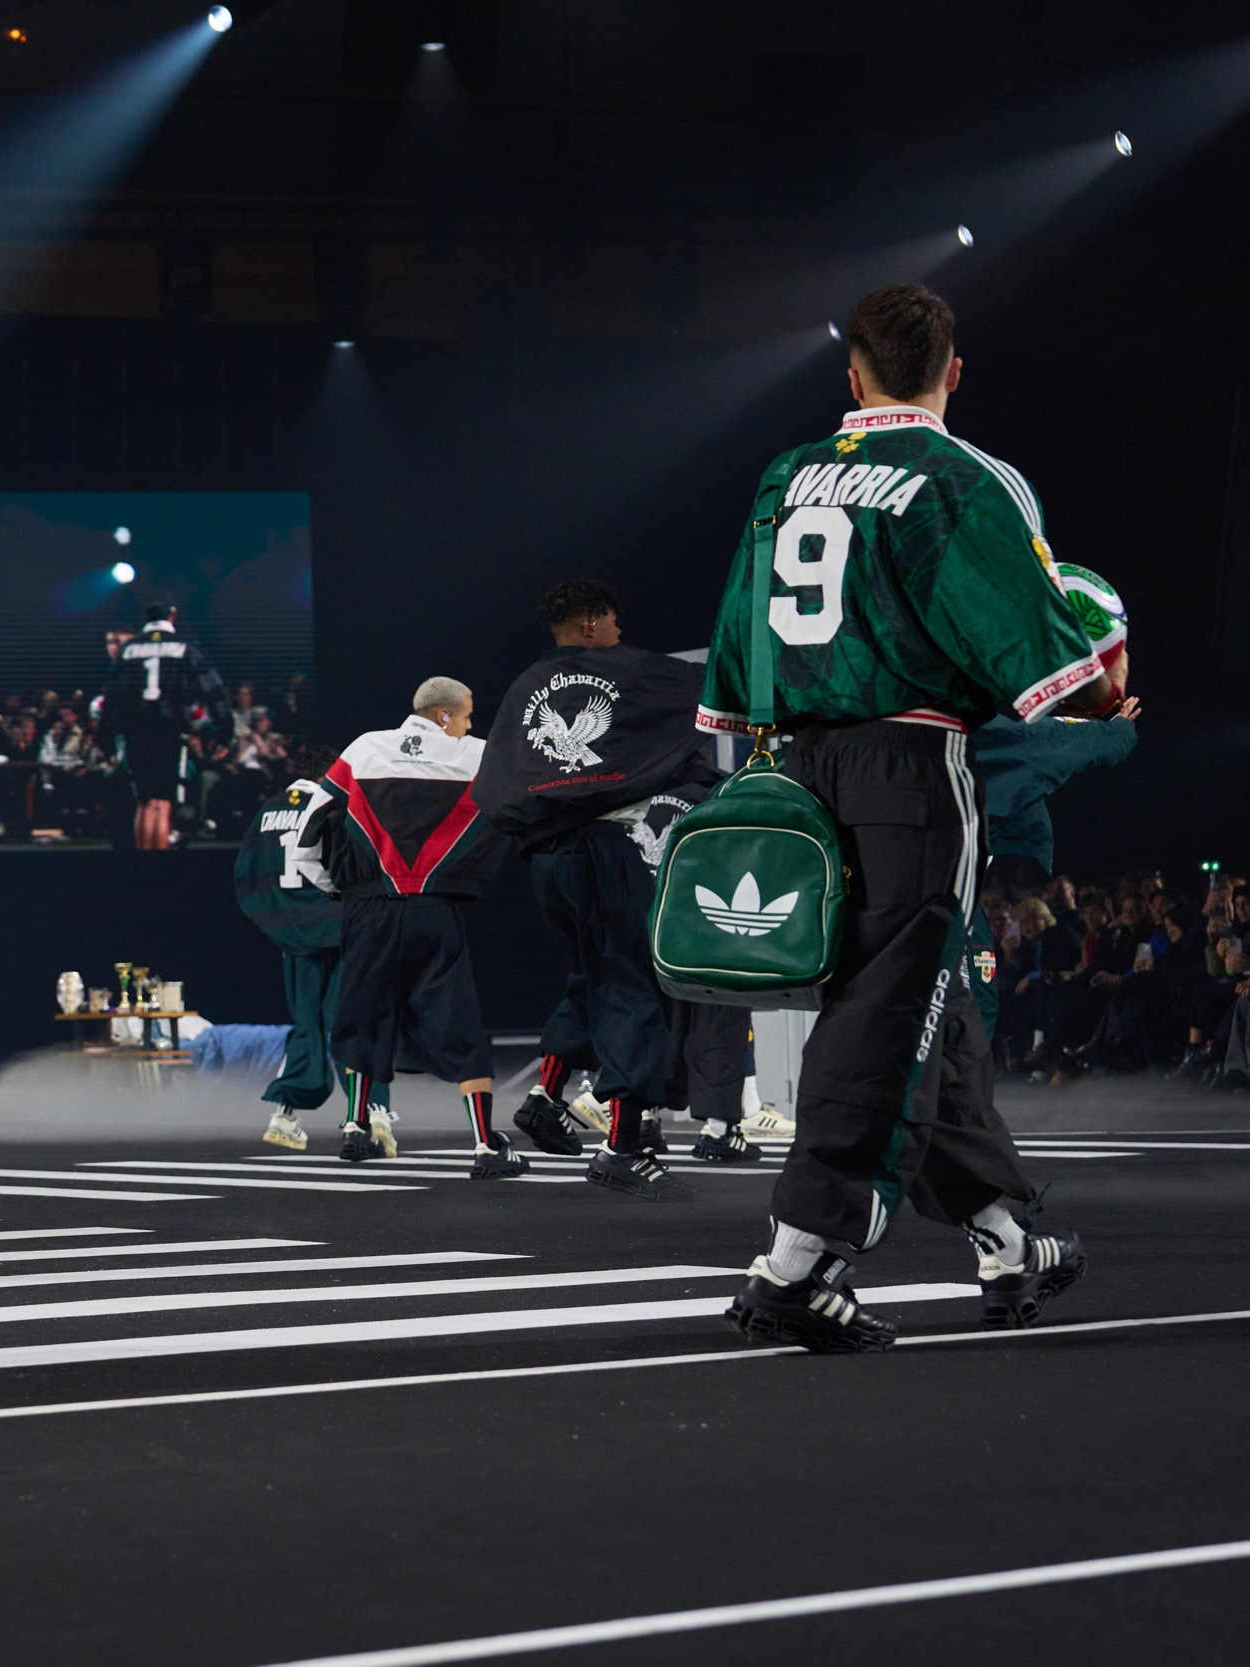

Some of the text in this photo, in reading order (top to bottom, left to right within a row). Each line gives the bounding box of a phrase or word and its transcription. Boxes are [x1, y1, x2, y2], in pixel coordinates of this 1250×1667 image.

[783, 463, 928, 517] AVARRIA
[768, 506, 854, 646] 9
[142, 656, 161, 700] 1
[522, 672, 621, 726] Willy Chavarria
[527, 779, 570, 792] Comienza
[571, 775, 588, 784] con
[589, 773, 598, 782] el
[260, 810, 306, 832] CHAVA
[279, 830, 303, 888] 1
[916, 968, 950, 1063] adidas
